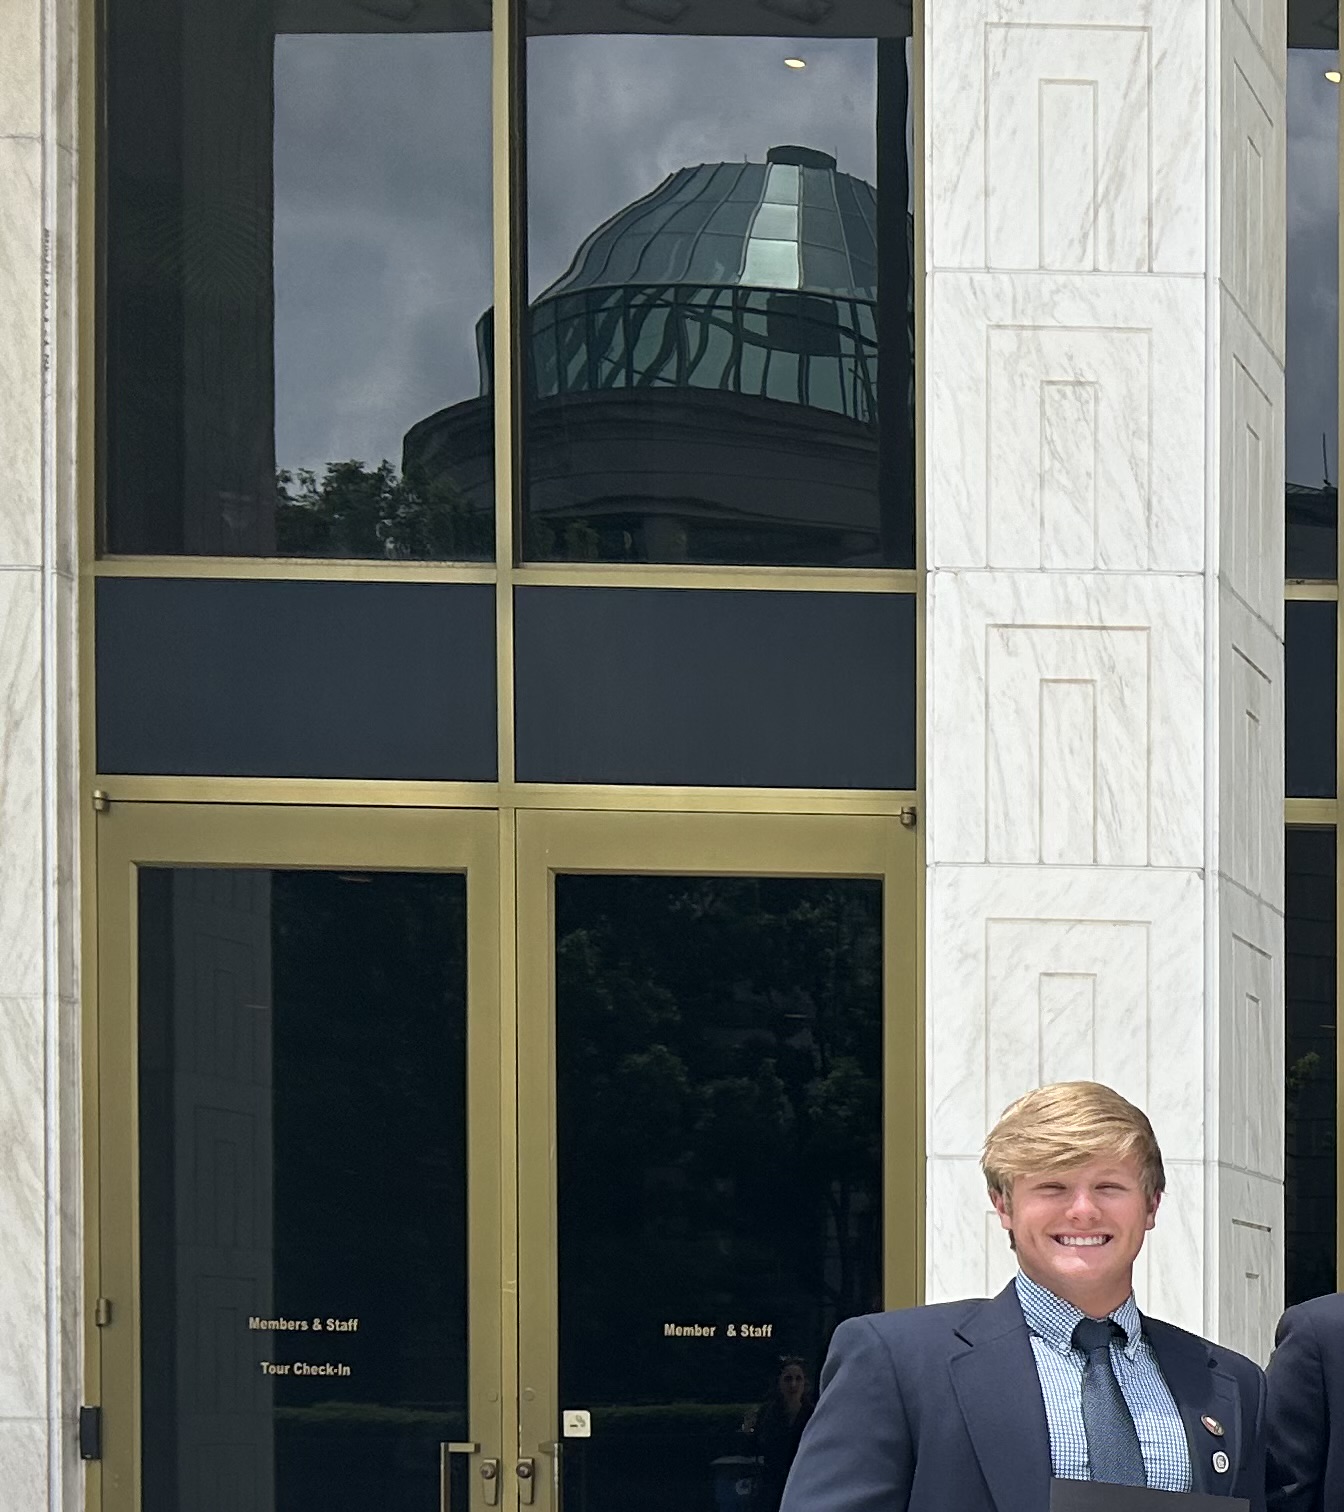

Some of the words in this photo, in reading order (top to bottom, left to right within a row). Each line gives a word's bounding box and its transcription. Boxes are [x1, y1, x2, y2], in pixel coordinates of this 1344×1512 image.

[248, 1317, 309, 1330] Members
[312, 1318, 322, 1331] &
[326, 1318, 359, 1332] Staff
[664, 1323, 716, 1337] Member
[727, 1324, 737, 1337] &
[740, 1324, 773, 1338] Staff
[260, 1361, 291, 1375] Tour
[293, 1362, 351, 1376] Check-In
